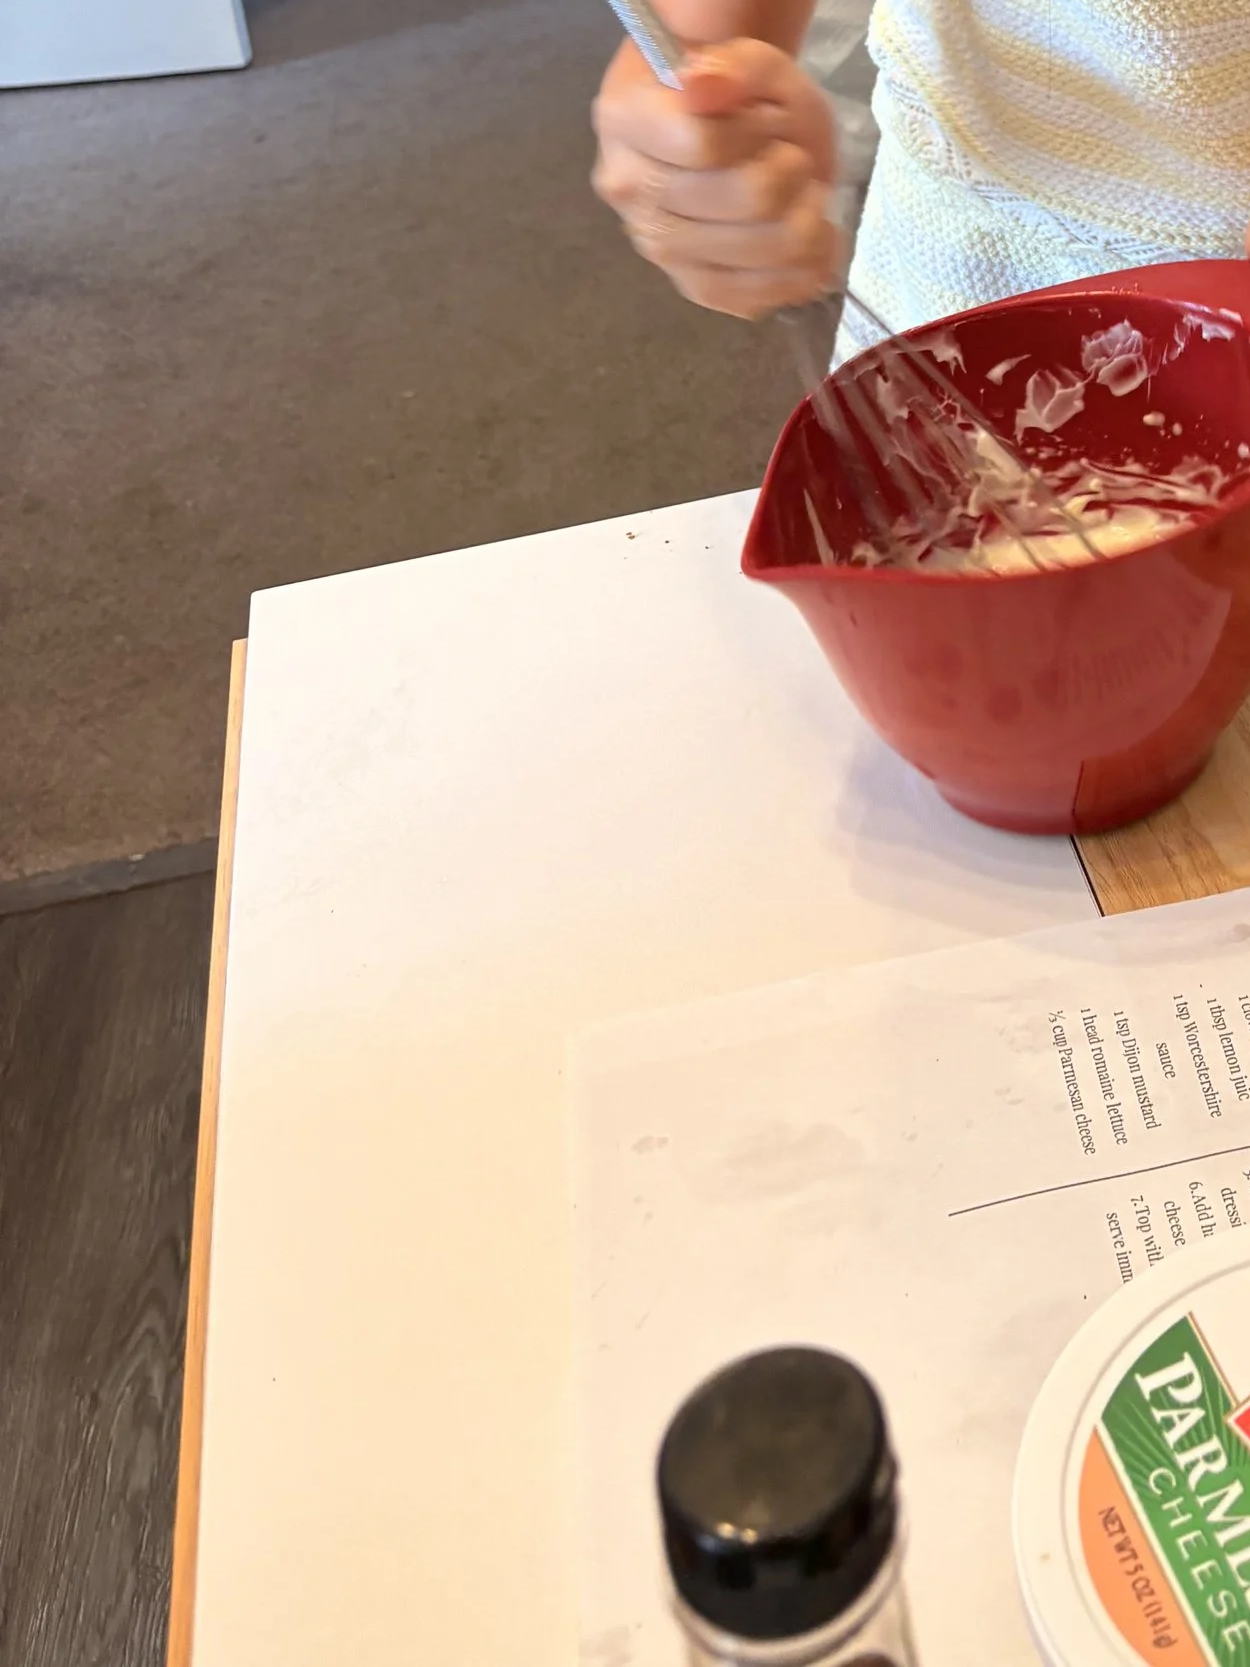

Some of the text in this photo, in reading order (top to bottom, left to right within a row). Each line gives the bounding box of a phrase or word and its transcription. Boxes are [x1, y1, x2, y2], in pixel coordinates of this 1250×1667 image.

[1205, 997, 1217, 1005] 1
[1208, 1004, 1227, 1031] tbsp
[1237, 994, 1249, 1002] 1
[1050, 1024, 1068, 1048] cup
[1081, 1013, 1104, 1046] head
[1114, 1017, 1131, 1037] tsp
[1089, 1045, 1115, 1101] romaine
[1120, 1036, 1141, 1074] Dijon
[1154, 1041, 1176, 1080] sauce
[1171, 993, 1222, 1119] 1 tsp Worcestershire
[1217, 1030, 1241, 1076] lemon
[1057, 1046, 1084, 1112] Parmesan
[1130, 1074, 1162, 1130] mustard
[1073, 1112, 1096, 1156] cheese
[1104, 1101, 1128, 1146] lettuce
[1104, 1211, 1125, 1249] serve
[1162, 1199, 1186, 1247] cheese
[1098, 1506, 1124, 1539] NET
[1113, 1533, 1136, 1563] WT
[1131, 1575, 1153, 1602] OZ
